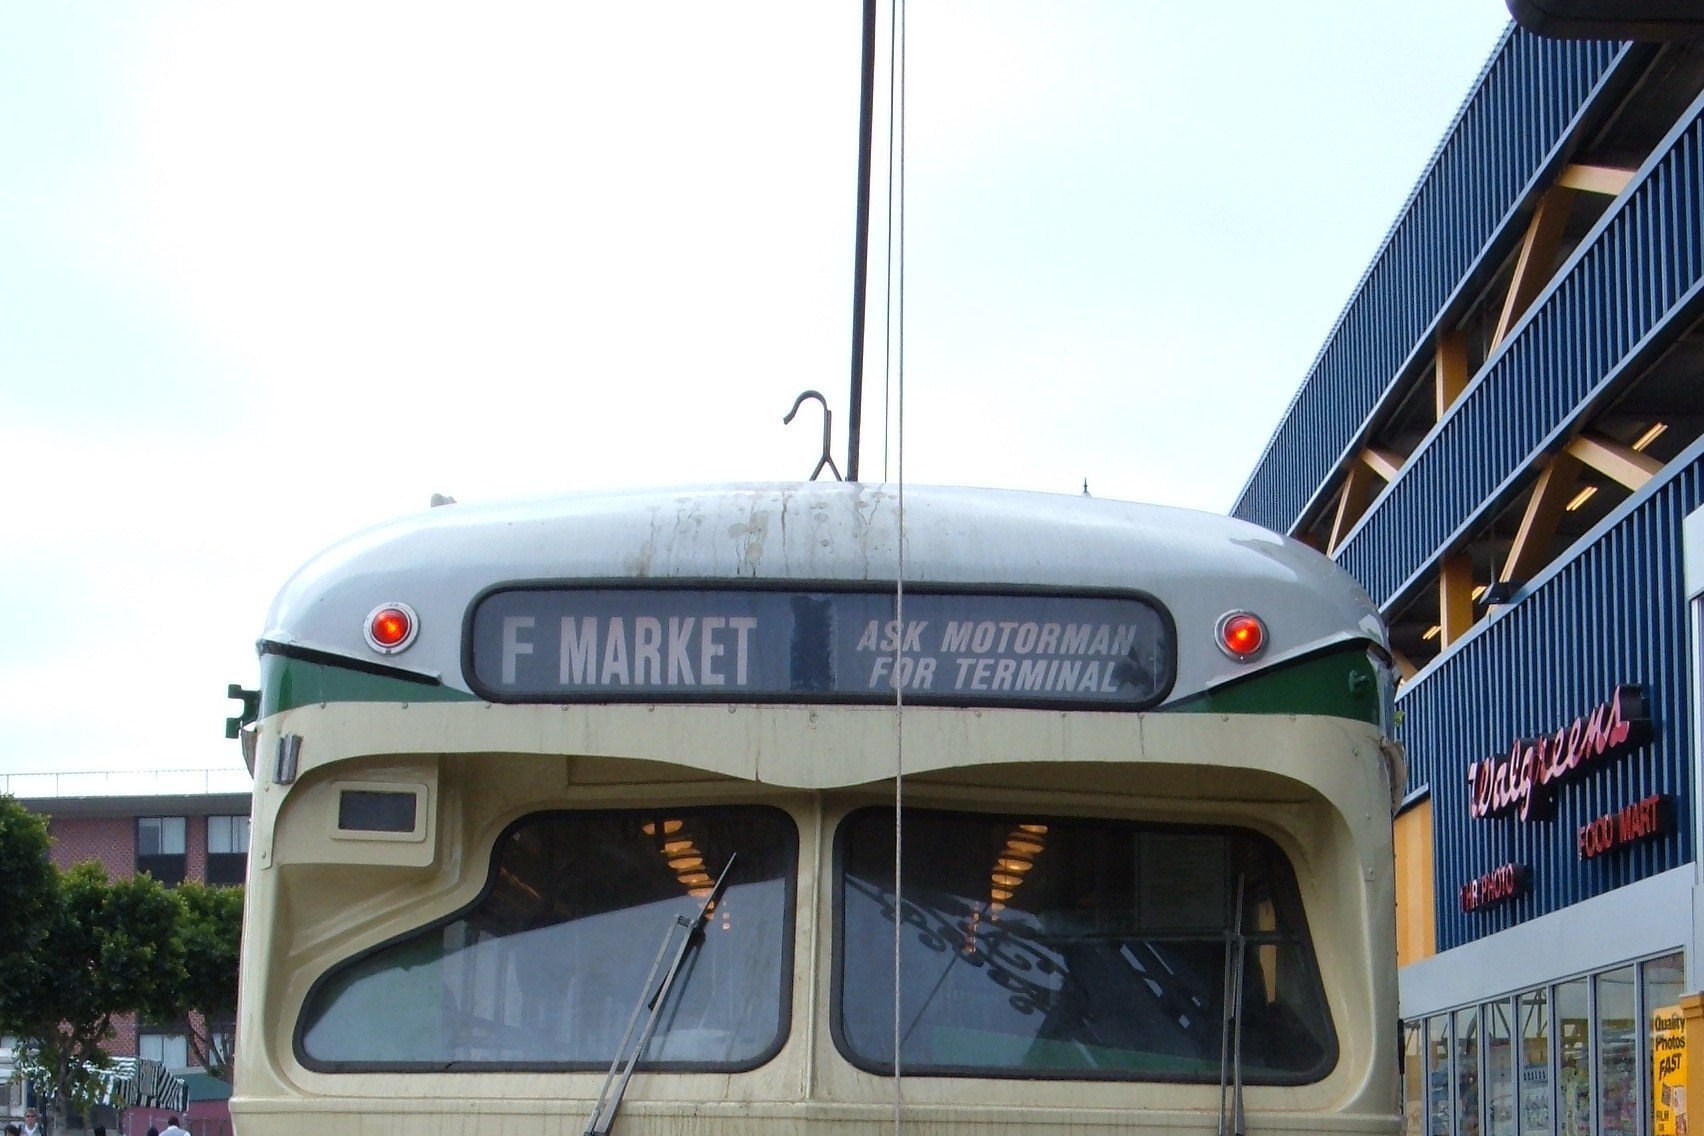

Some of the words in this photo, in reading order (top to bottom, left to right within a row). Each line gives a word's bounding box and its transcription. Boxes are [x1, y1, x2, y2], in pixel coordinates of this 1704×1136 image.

[502, 616, 536, 684] F
[559, 616, 758, 685] MARKET
[857, 620, 928, 651] ASK
[940, 621, 1137, 656] MOTORMAN
[869, 656, 937, 690] FOR
[953, 657, 1118, 693] TERMINAL
[1468, 684, 1630, 823] Walgreens
[1577, 814, 1613, 859] FOOD
[1619, 795, 1660, 843] MART
[1481, 863, 1514, 903] PHOTO
[1655, 1013, 1685, 1032] Quality
[1655, 1034, 1685, 1052] Photos
[1659, 1053, 1682, 1081] FAST
